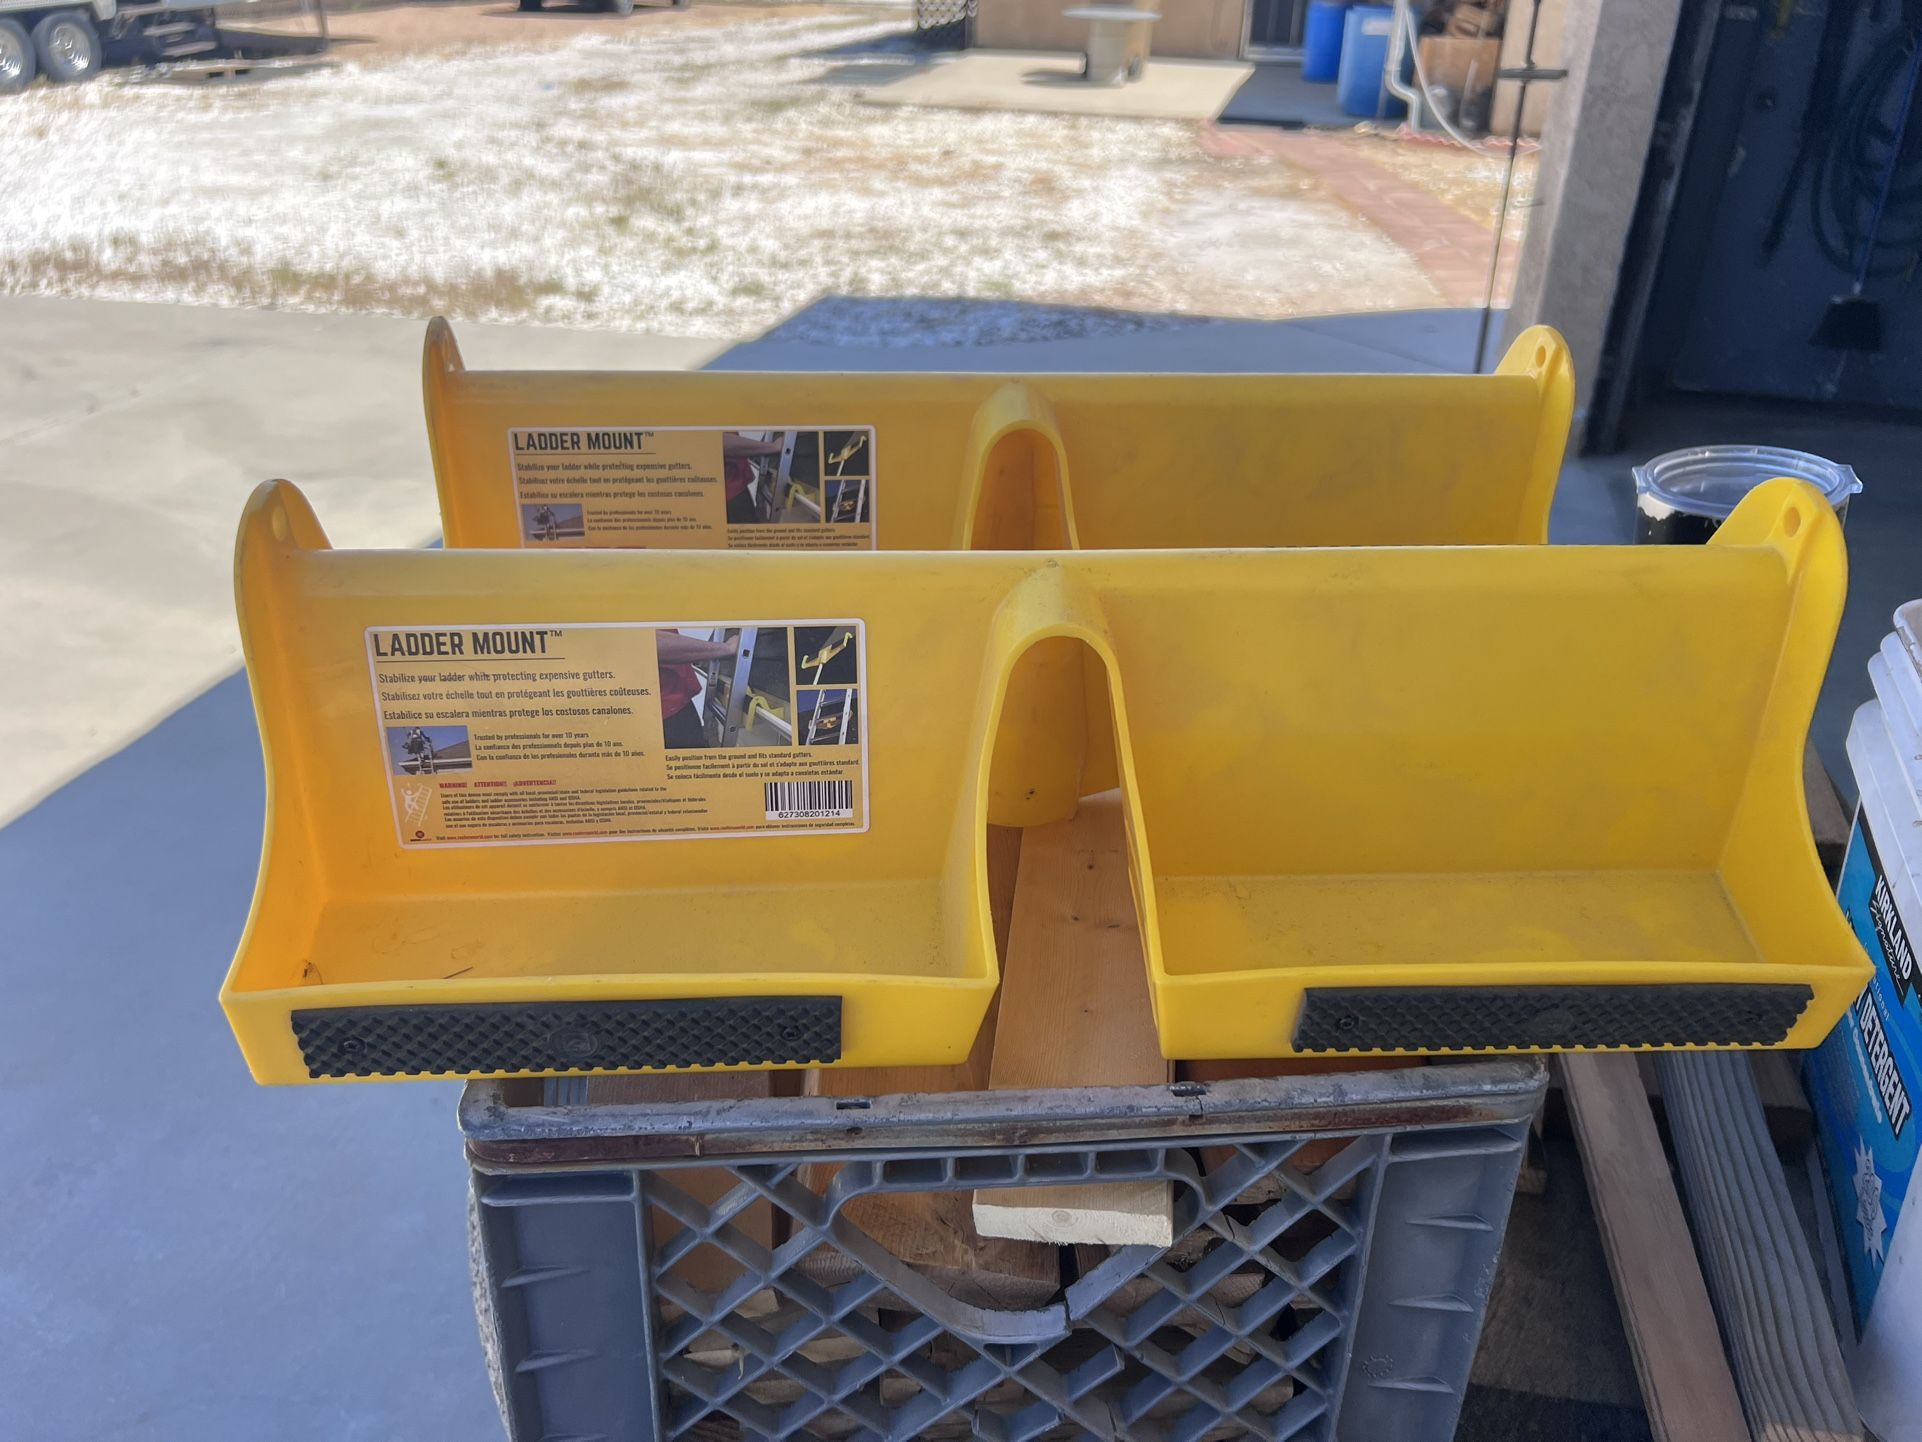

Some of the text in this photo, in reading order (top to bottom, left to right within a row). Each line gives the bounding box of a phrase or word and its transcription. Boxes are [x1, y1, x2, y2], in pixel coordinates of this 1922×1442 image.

[514, 432, 581, 450] LADDER
[373, 631, 464, 657] LADDER
[378, 670, 616, 685] Stabilize your ladder while protecting expensive gutters.
[383, 705, 634, 719] Estabilice su escalera mientras protege los costosos canalones.
[778, 810, 841, 819] 627308201214
[1875, 875, 1912, 980] KIRKLAND
[1870, 900, 1904, 996] Signature
[1860, 992, 1911, 1135] DETERGENT
